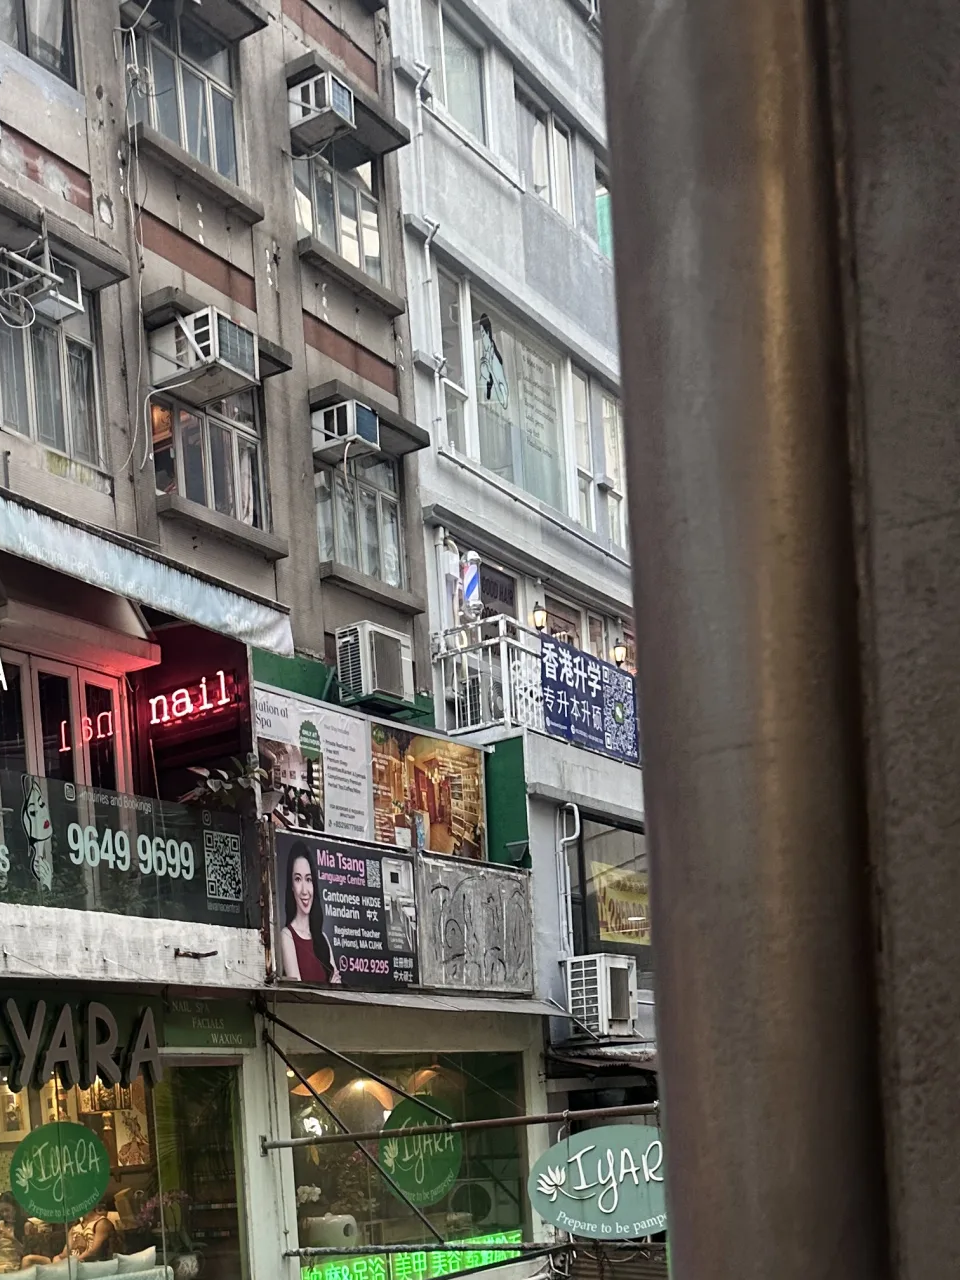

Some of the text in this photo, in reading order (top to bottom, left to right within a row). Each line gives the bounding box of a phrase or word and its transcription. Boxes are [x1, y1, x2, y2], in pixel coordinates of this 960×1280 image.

[542, 642, 601, 698] 香港升学
[149, 670, 231, 724] nail
[256, 713, 272, 729] Spa
[67, 822, 195, 881] 9649 9699
[316, 849, 365, 878] Mia Tsang
[318, 870, 366, 887] Language Centre
[322, 889, 360, 905] Cantonese
[325, 904, 360, 920] Mandarin
[333, 925, 361, 939] Registered
[349, 957, 390, 975] 5402 9295
[211, 1033, 243, 1045] WAXING
[28, 1199, 54, 1218] Prepare
[556, 1211, 598, 1232] Prepare
[601, 1222, 612, 1233] to
[616, 1221, 630, 1233] be
